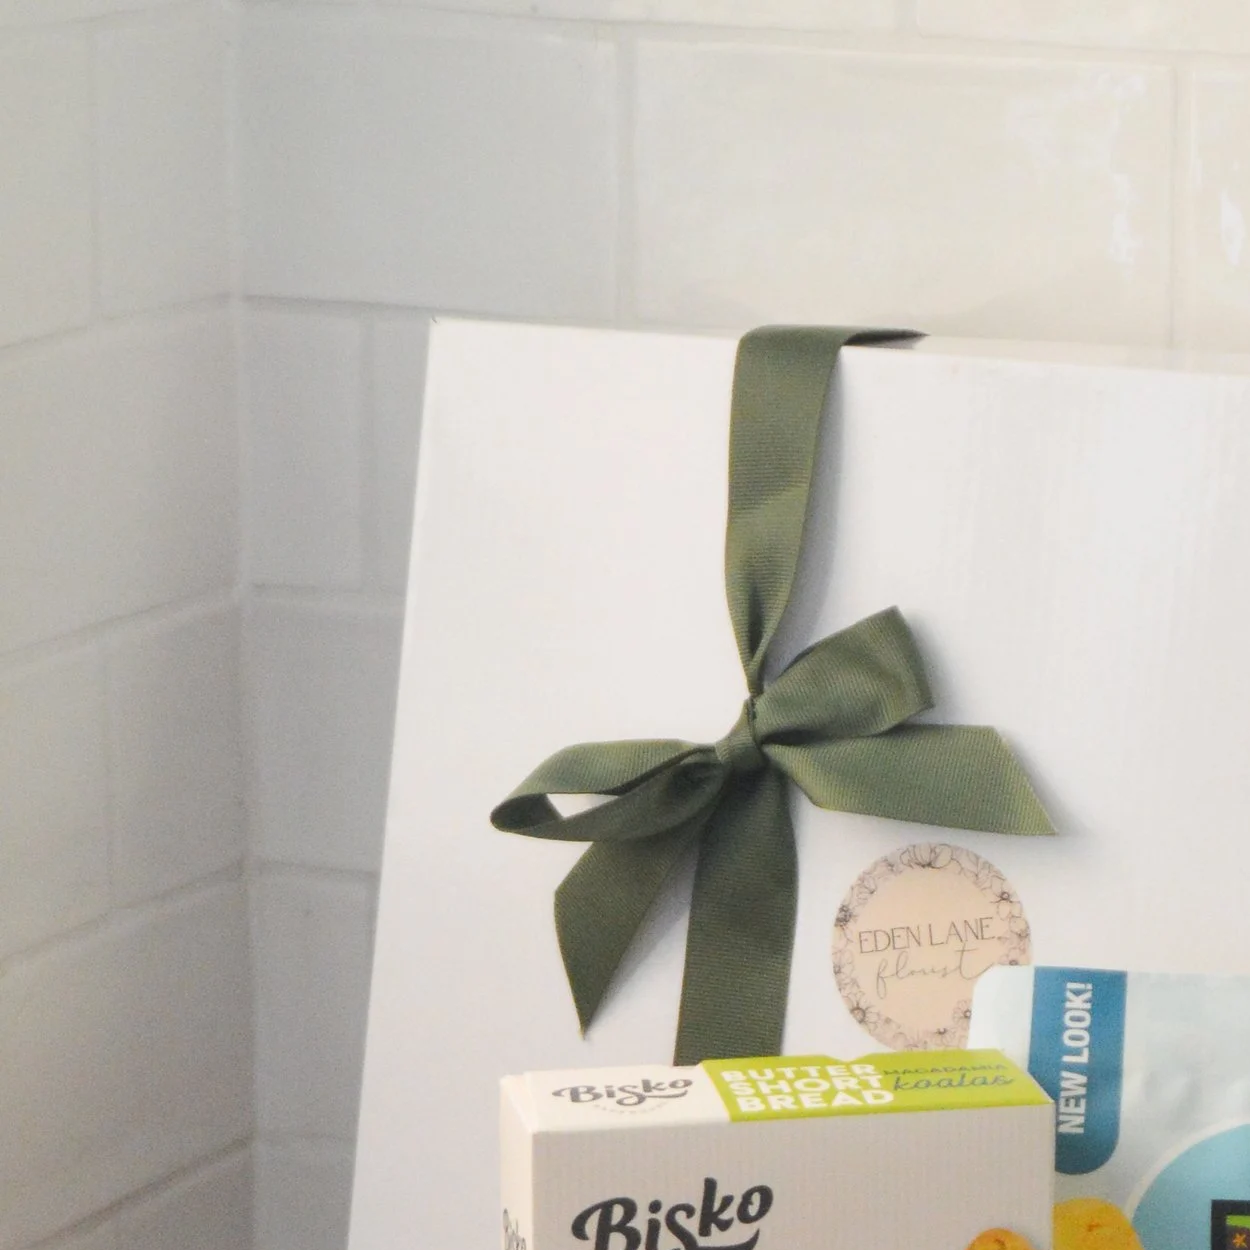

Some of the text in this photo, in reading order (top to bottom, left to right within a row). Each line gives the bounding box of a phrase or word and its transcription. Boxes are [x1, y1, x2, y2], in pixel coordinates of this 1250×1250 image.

[857, 917, 995, 954] EDEN LANE
[1056, 982, 1094, 1134] NEW LOOK!
[720, 1064, 876, 1081] BUTTER
[730, 1075, 882, 1096] SHORT
[551, 1078, 693, 1107] Bisko
[736, 1088, 895, 1112] BREAD
